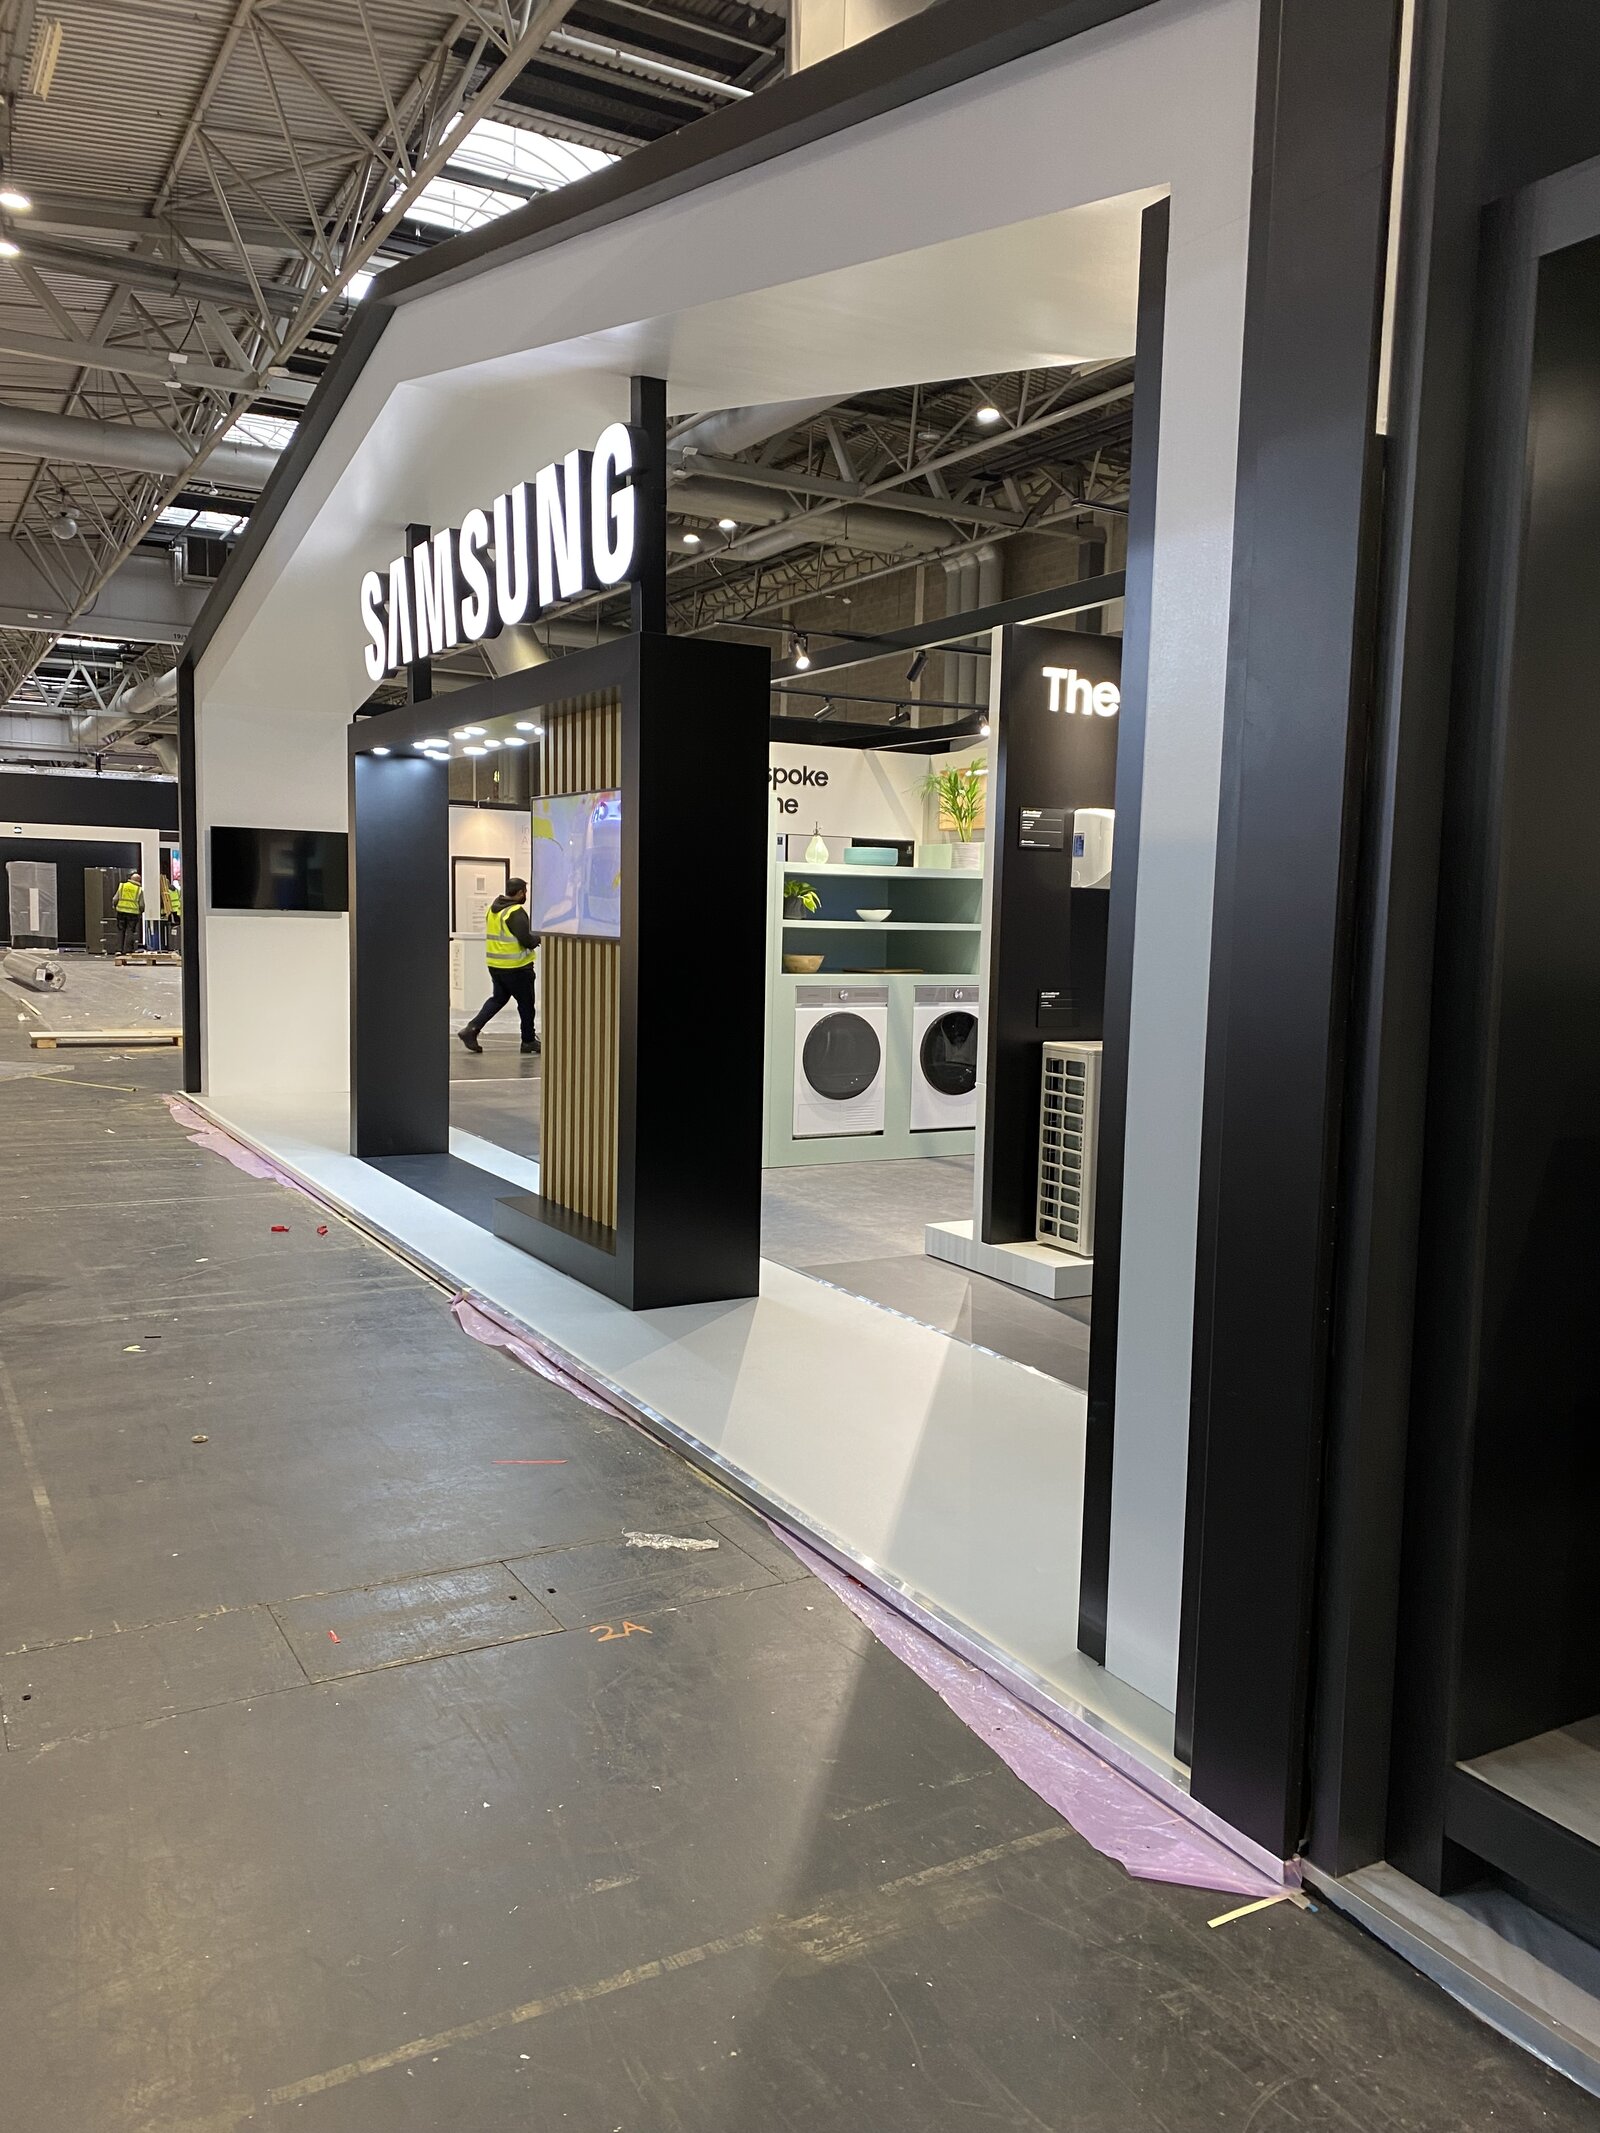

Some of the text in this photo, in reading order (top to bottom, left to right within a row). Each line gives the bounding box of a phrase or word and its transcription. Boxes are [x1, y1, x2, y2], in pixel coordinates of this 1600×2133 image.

[361, 422, 635, 682] SAMSUNG
[1042, 666, 1121, 717] The
[589, 1621, 653, 1642] 2A
